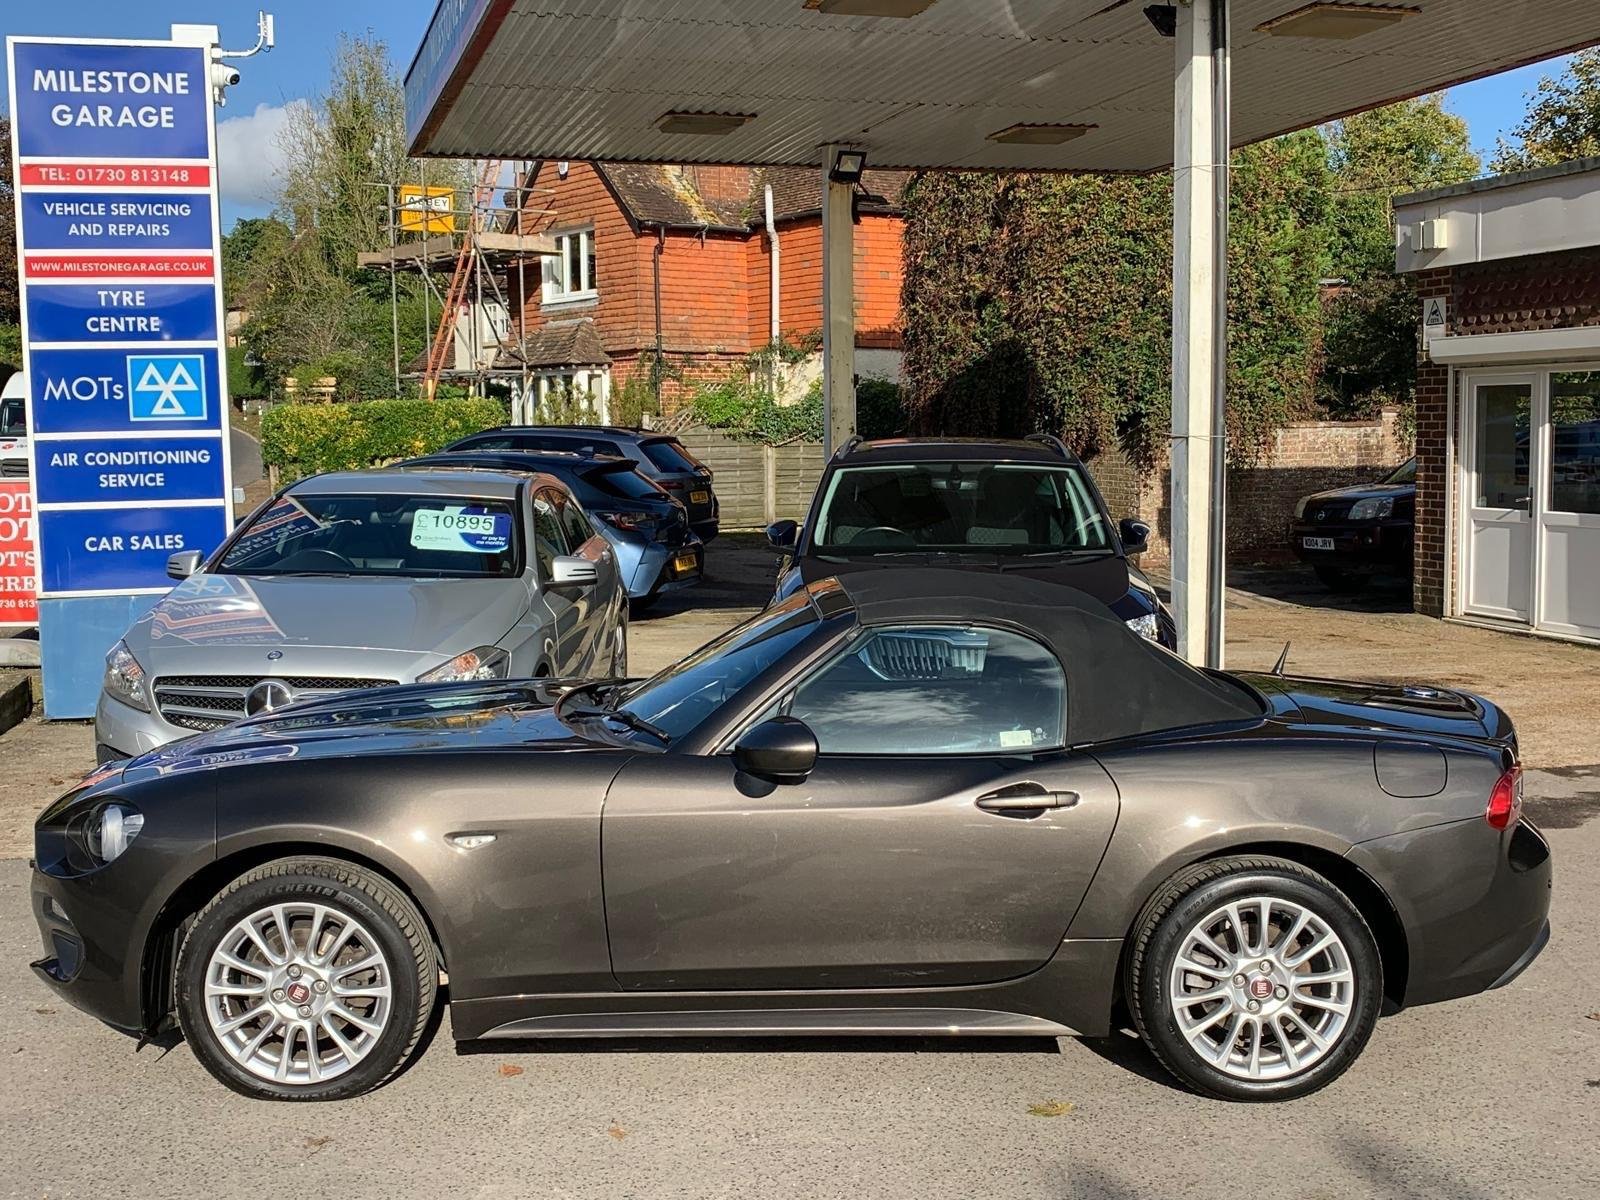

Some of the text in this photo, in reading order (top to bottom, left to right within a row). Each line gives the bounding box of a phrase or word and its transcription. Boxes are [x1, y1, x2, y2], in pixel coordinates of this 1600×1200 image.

[33, 69, 190, 95] MILESTONE
[51, 104, 175, 129] GARAGE
[39, 167, 190, 183] TEL: 01730 813148
[43, 202, 192, 217] VEHICLE SERVICING
[68, 223, 171, 237] AND REPAIRS
[31, 261, 208, 273] WWW.MILESTONEGARAGE.CO.UK
[97, 290, 146, 307] TYRE
[86, 316, 160, 333] CENTRE
[43, 376, 125, 401] MOTs
[50, 449, 211, 467] AIR CONDITIONING
[99, 472, 165, 488] SERVICE
[85, 534, 184, 552] CAR SALES
